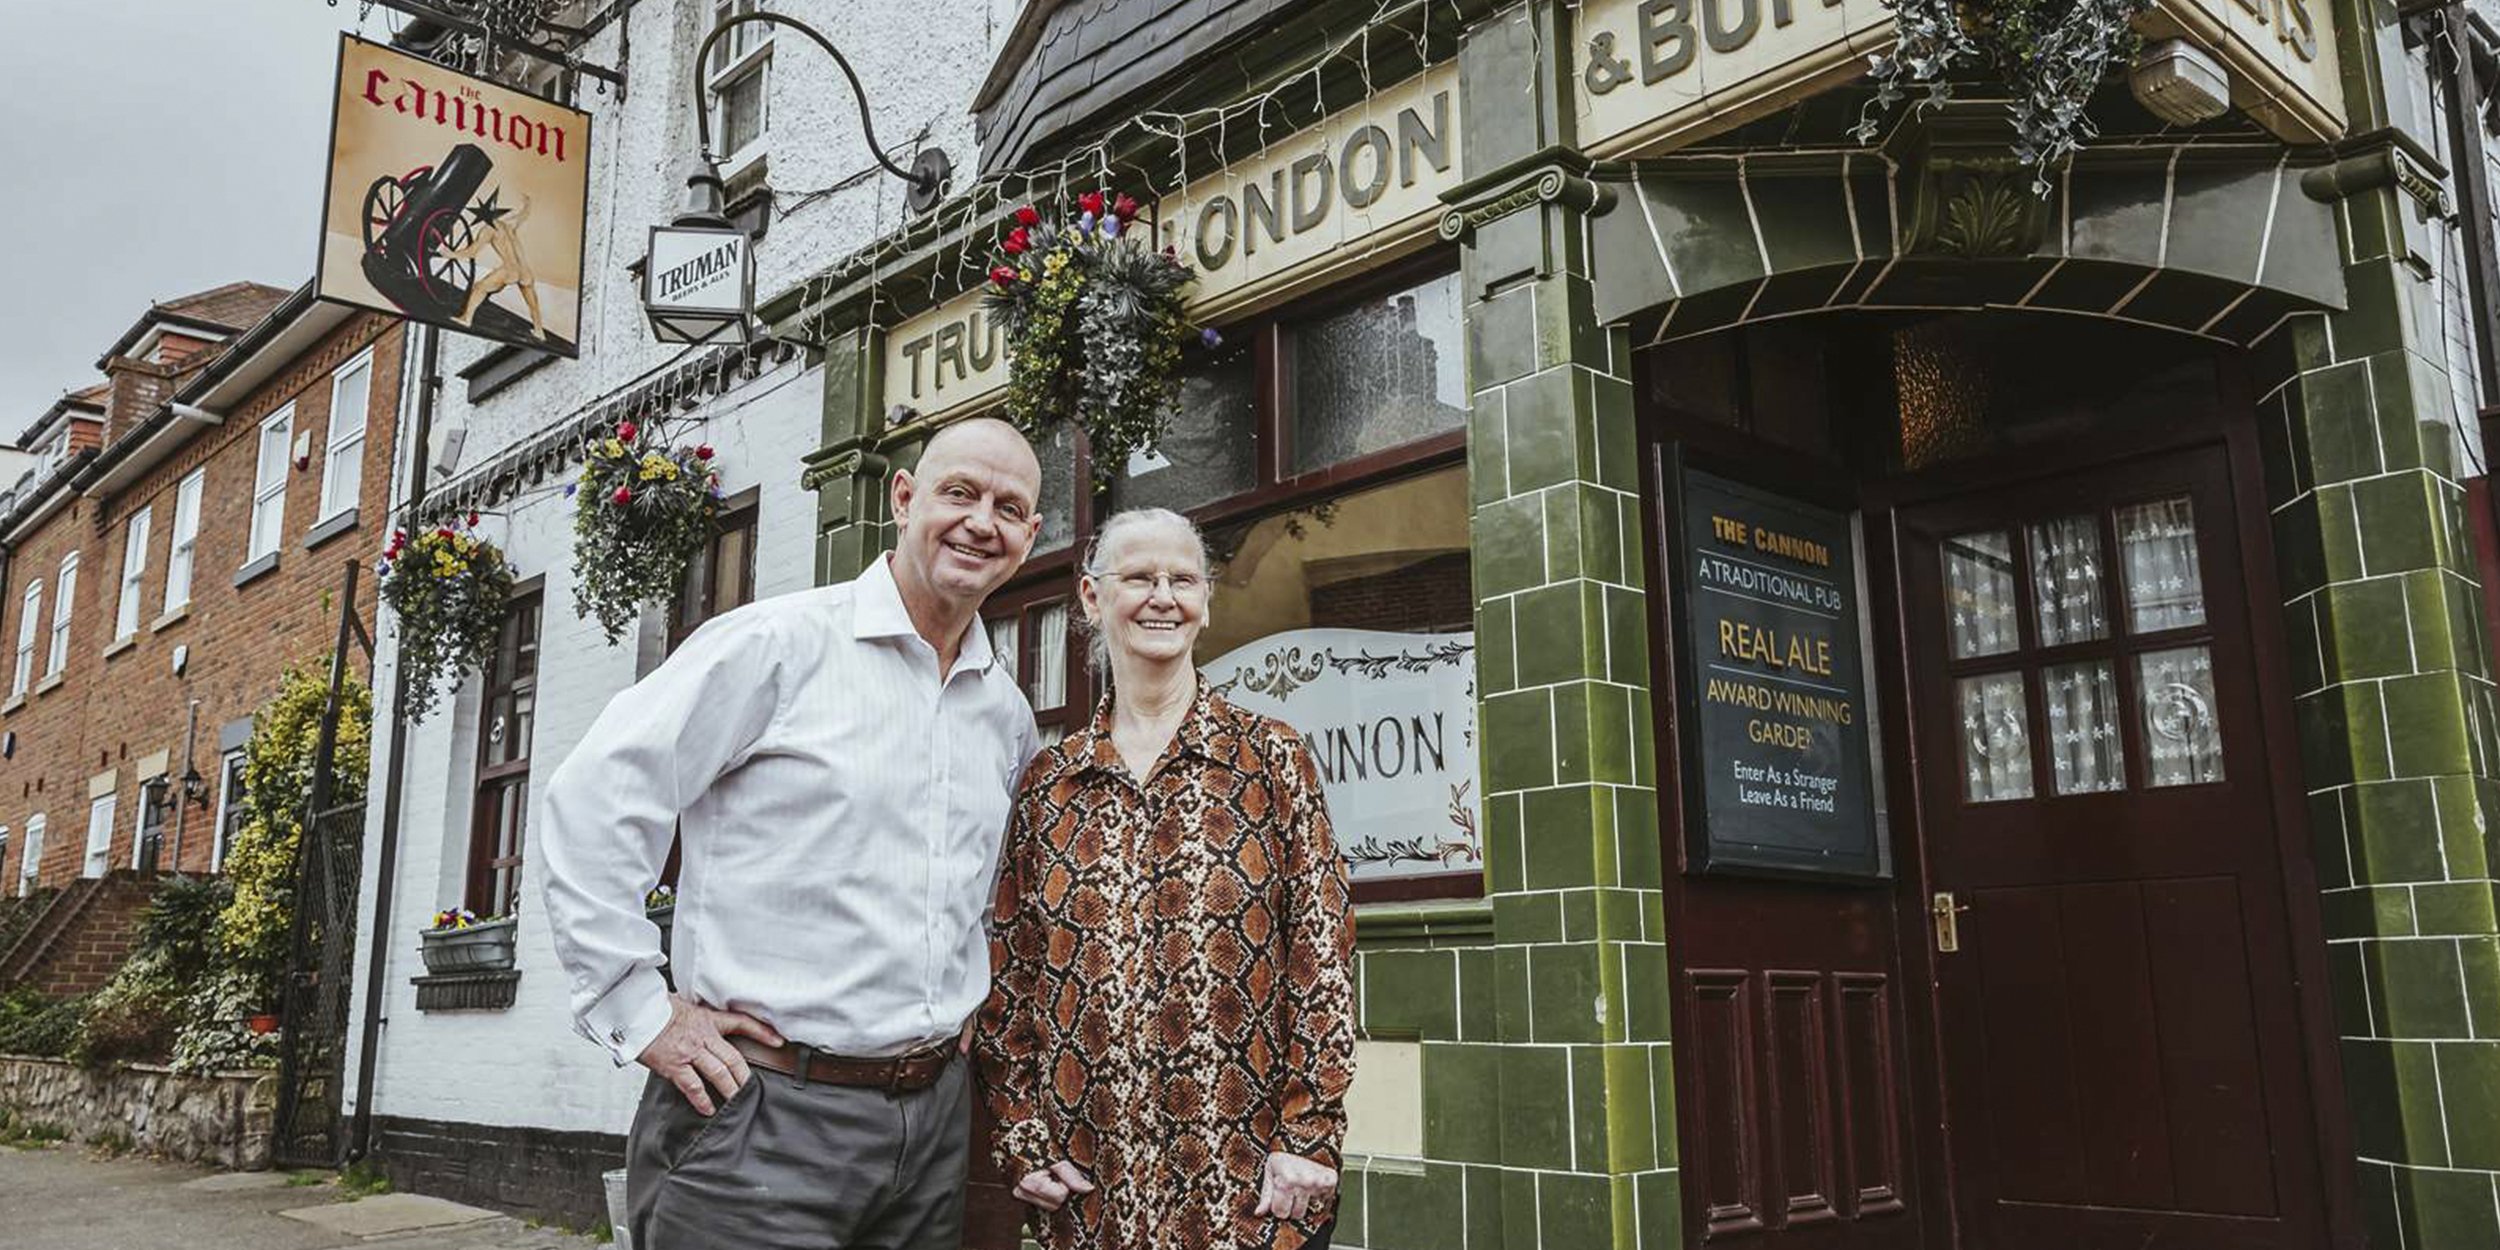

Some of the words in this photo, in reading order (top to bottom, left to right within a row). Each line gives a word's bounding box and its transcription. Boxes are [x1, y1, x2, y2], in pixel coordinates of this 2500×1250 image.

[1585, 31, 1634, 95] &
[657, 238, 740, 299] TRUMAN
[902, 310, 1012, 399] TRU
[1712, 515, 1749, 545] THE
[1754, 527, 1829, 567] CANNON
[1699, 558, 1711, 580] A
[1711, 559, 1813, 604] TRADITIONAL
[1815, 586, 1842, 610] PUB
[1720, 618, 1784, 666] REAL
[1787, 633, 1832, 675] ALE
[1707, 677, 1772, 711] AWARD
[1773, 689, 1851, 725] WINNING
[1303, 712, 1445, 785] NNON
[1734, 760, 1765, 781] Enter
[1766, 765, 1782, 784] As
[1784, 772, 1791, 785] a
[1792, 768, 1837, 795] Stranger
[1740, 783, 1772, 806] Leave
[1773, 788, 1788, 807] As
[1790, 796, 1798, 809] a
[1800, 791, 1835, 813] Friend
